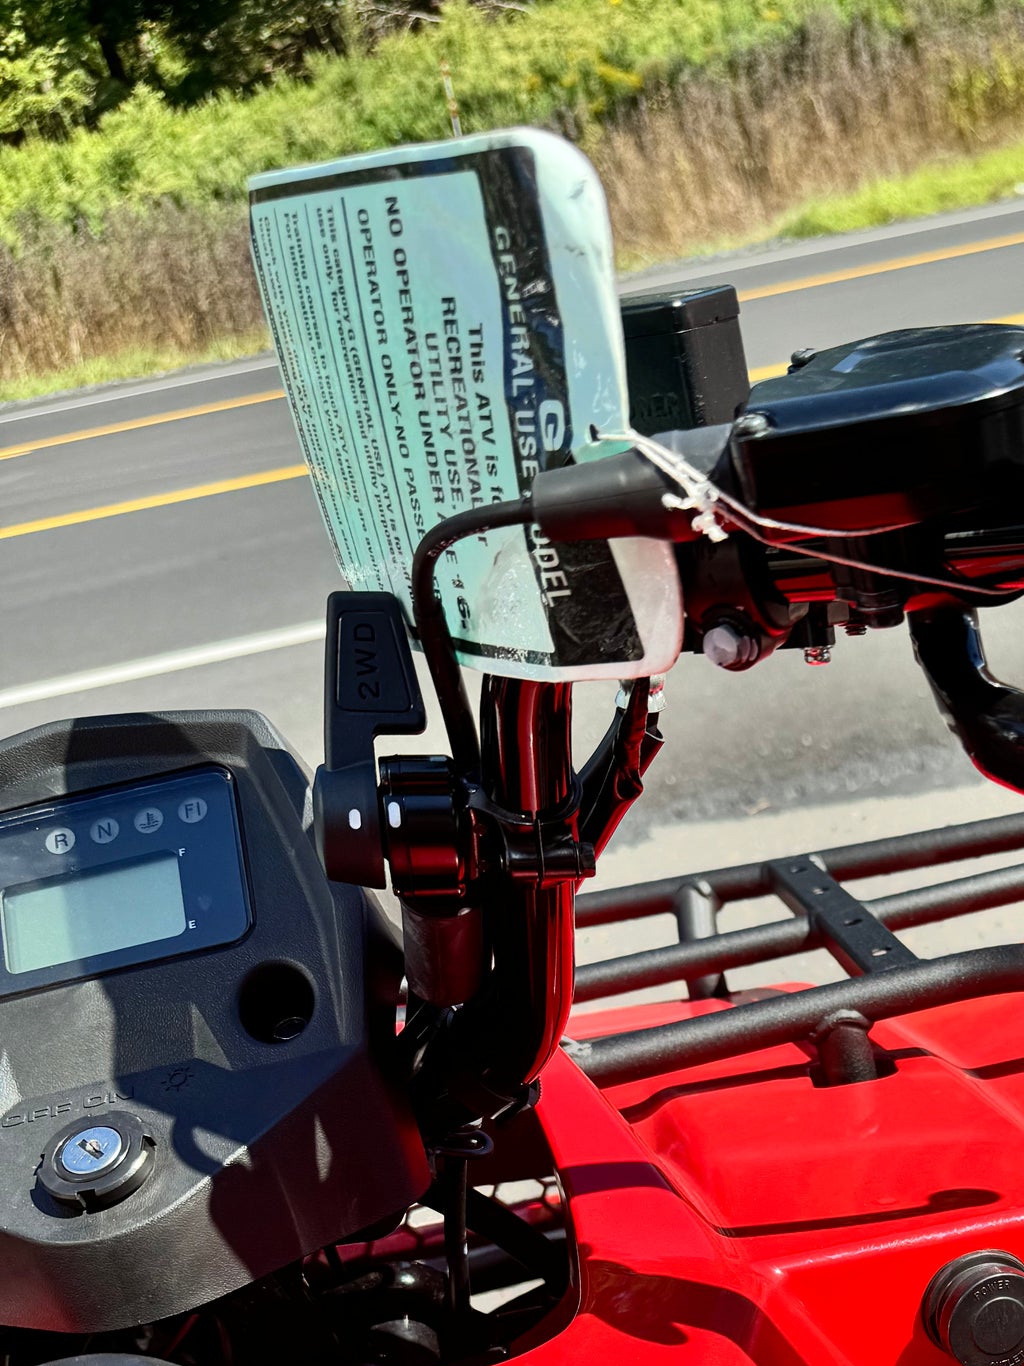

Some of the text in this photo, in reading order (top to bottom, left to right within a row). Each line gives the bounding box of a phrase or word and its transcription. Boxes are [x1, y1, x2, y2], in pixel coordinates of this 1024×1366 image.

[326, 205, 337, 243] This
[384, 195, 403, 238] NO
[333, 248, 351, 323] category
[284, 211, 292, 240] For
[290, 245, 312, 342] information
[311, 345, 327, 404] contact
[325, 409, 336, 443] your
[316, 207, 325, 238] use
[331, 290, 339, 314] for
[336, 319, 359, 404] recreation
[356, 408, 367, 439] and
[364, 443, 378, 488] utility
[347, 328, 354, 340] G
[356, 208, 388, 345] OPERATOR
[380, 353, 410, 459] ONLY-NO
[391, 246, 426, 400] OPERATOR
[291, 210, 383, 591] Training courses to teach ATV riding are availab
[350, 346, 374, 434] (GENERAL
[424, 330, 453, 437] UTILITY
[442, 447, 465, 510] USE,
[440, 295, 484, 509] RECREATIONAL
[467, 322, 503, 503] This ATV is fo
[495, 227, 571, 608] GENERAL USE ODEL
[371, 438, 384, 477] USE)
[417, 408, 445, 504] UNDER
[538, 400, 565, 452] G
[382, 482, 392, 513] ATV
[390, 518, 396, 531] is
[394, 535, 402, 555] for
[437, 510, 457, 565] AE
[353, 624, 379, 699] 2WD
[54, 833, 69, 850] R
[98, 822, 113, 839] N
[178, 848, 186, 857] F
[189, 919, 196, 929] E
[1, 1087, 135, 1128] OFF ON
